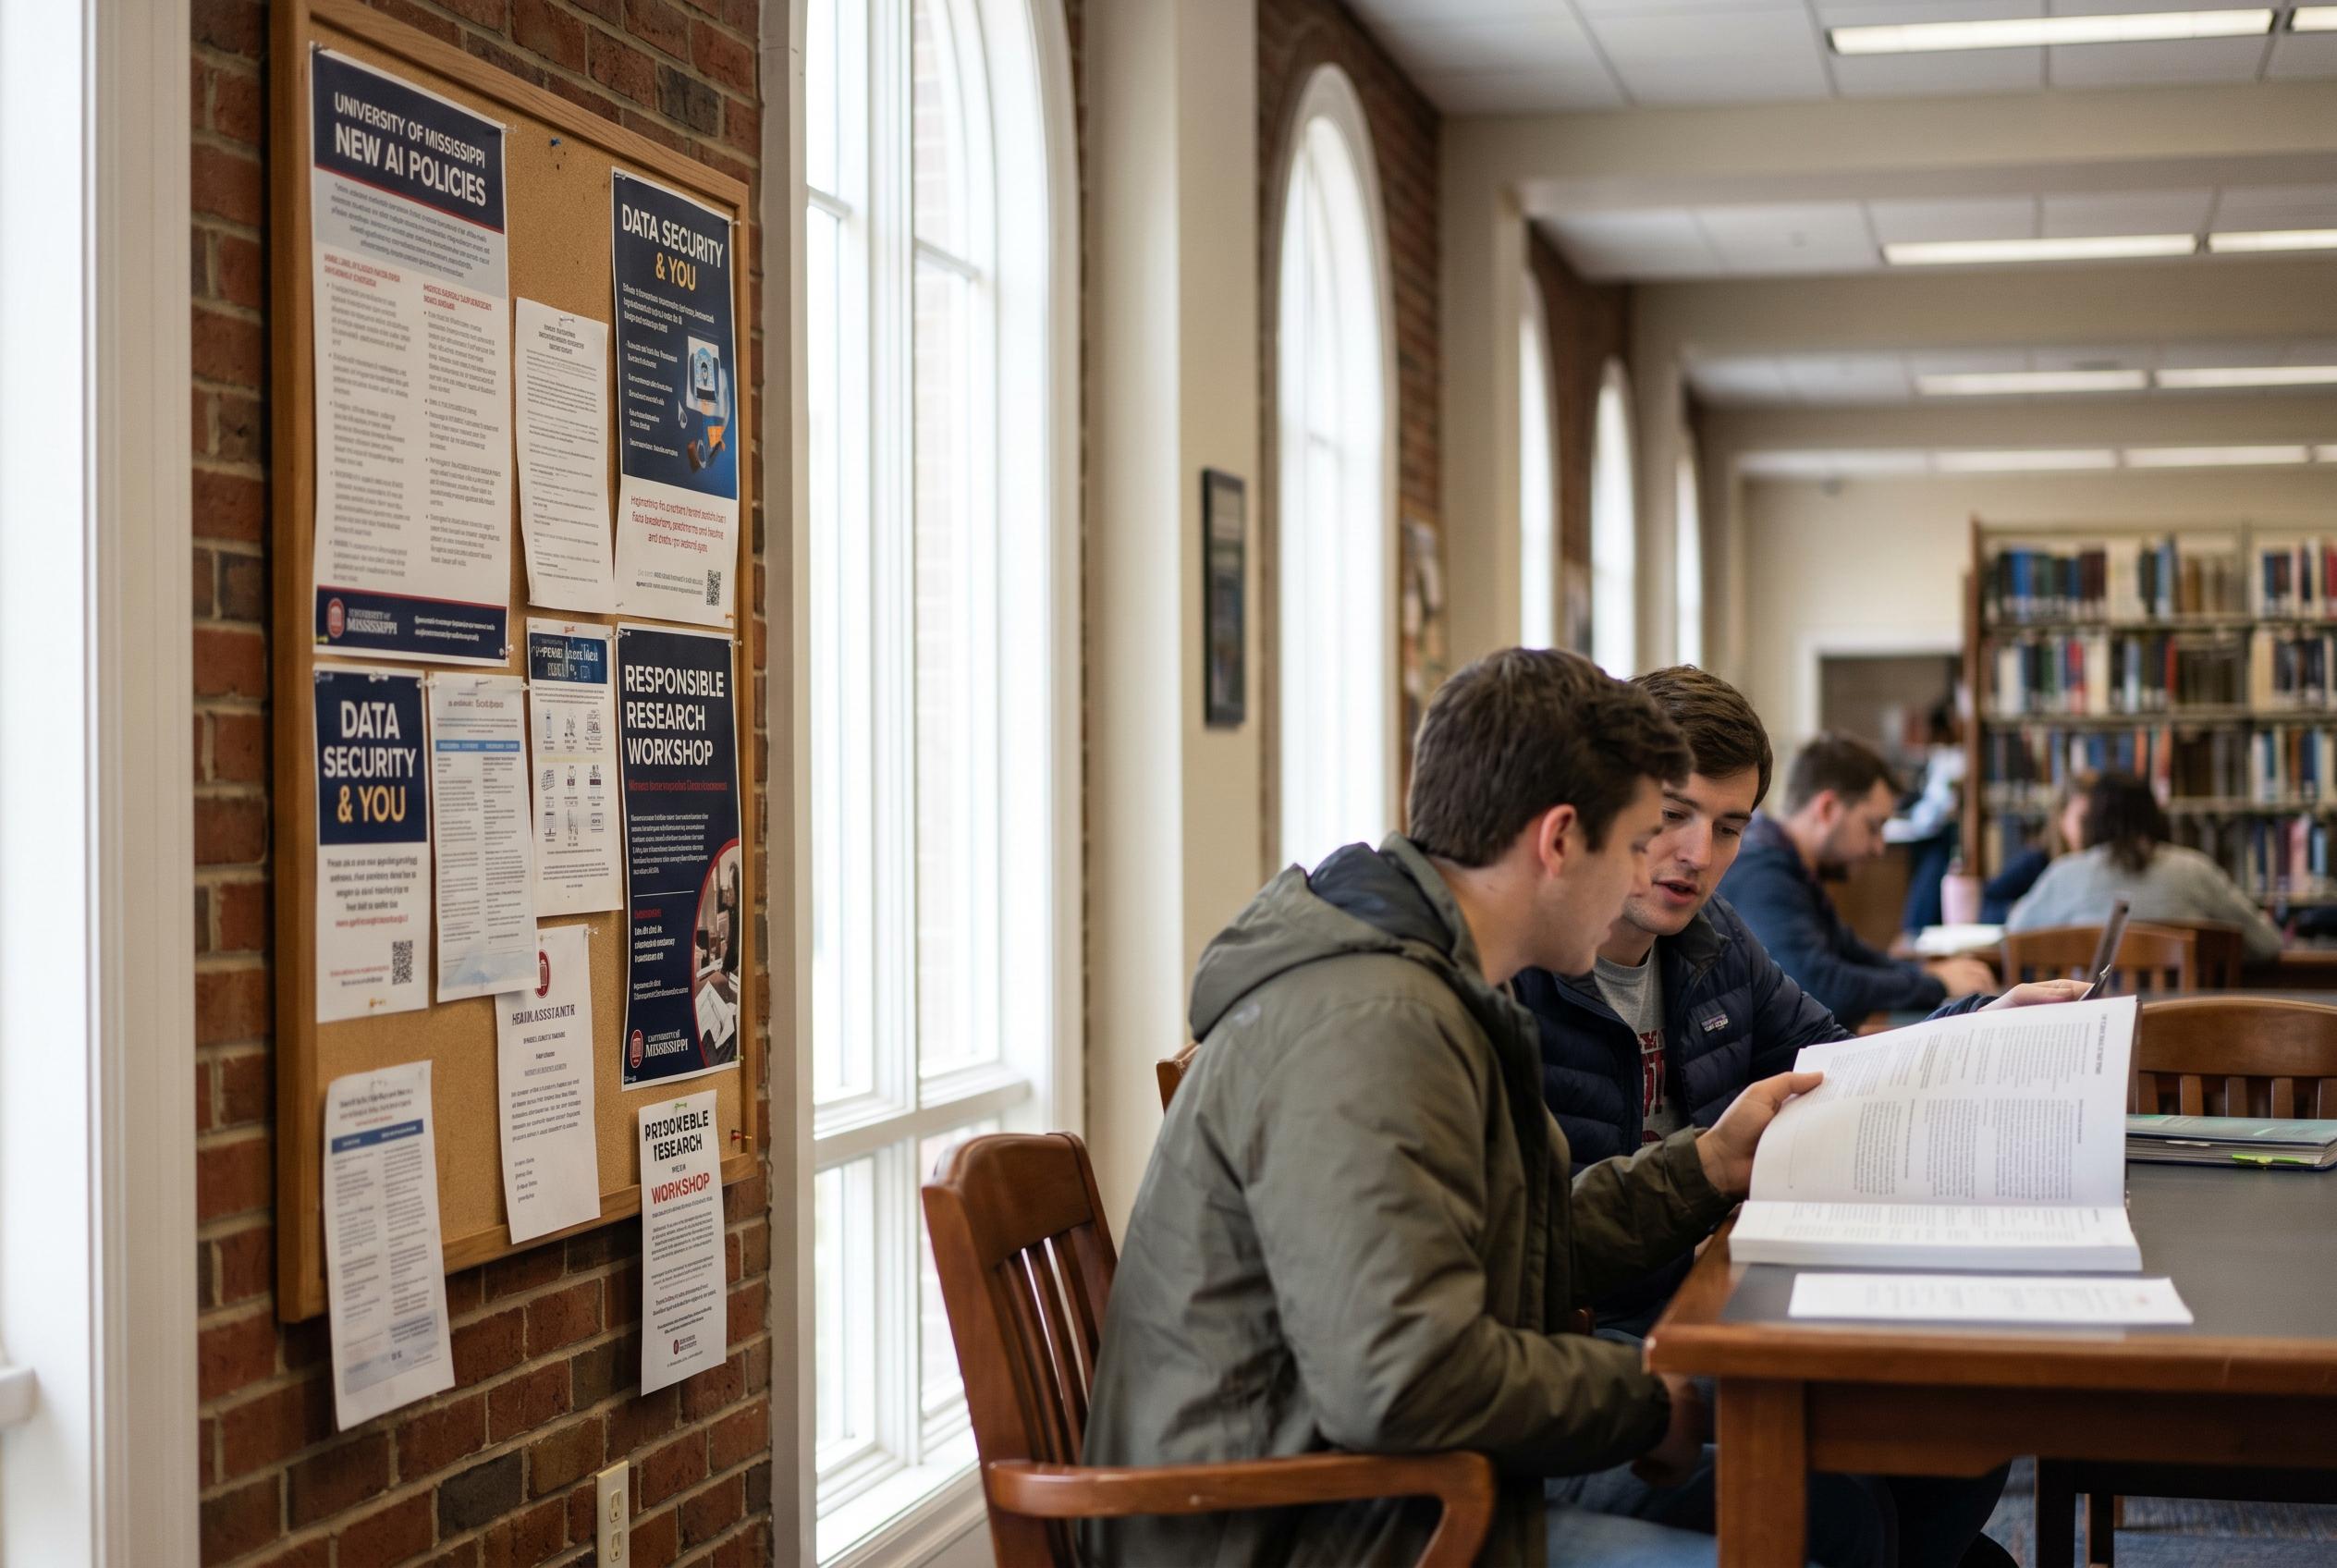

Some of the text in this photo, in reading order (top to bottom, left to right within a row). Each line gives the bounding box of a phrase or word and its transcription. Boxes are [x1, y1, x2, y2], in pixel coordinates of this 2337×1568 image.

[335, 92, 485, 168] UNIVERSITY OF MISSISSIPPI
[336, 122, 486, 206] NEW AI POLICIES
[622, 203, 723, 268] DATA SECURITY
[655, 251, 696, 291] & YOU
[625, 665, 725, 697] RESPONSIBLE
[340, 700, 400, 740] DATA
[626, 701, 705, 730] RESEARCH
[324, 745, 417, 778] SECURITY
[627, 738, 714, 766] WORKSHOP
[337, 785, 406, 823] & YOU
[651, 1172, 710, 1205] WORKSHOP
